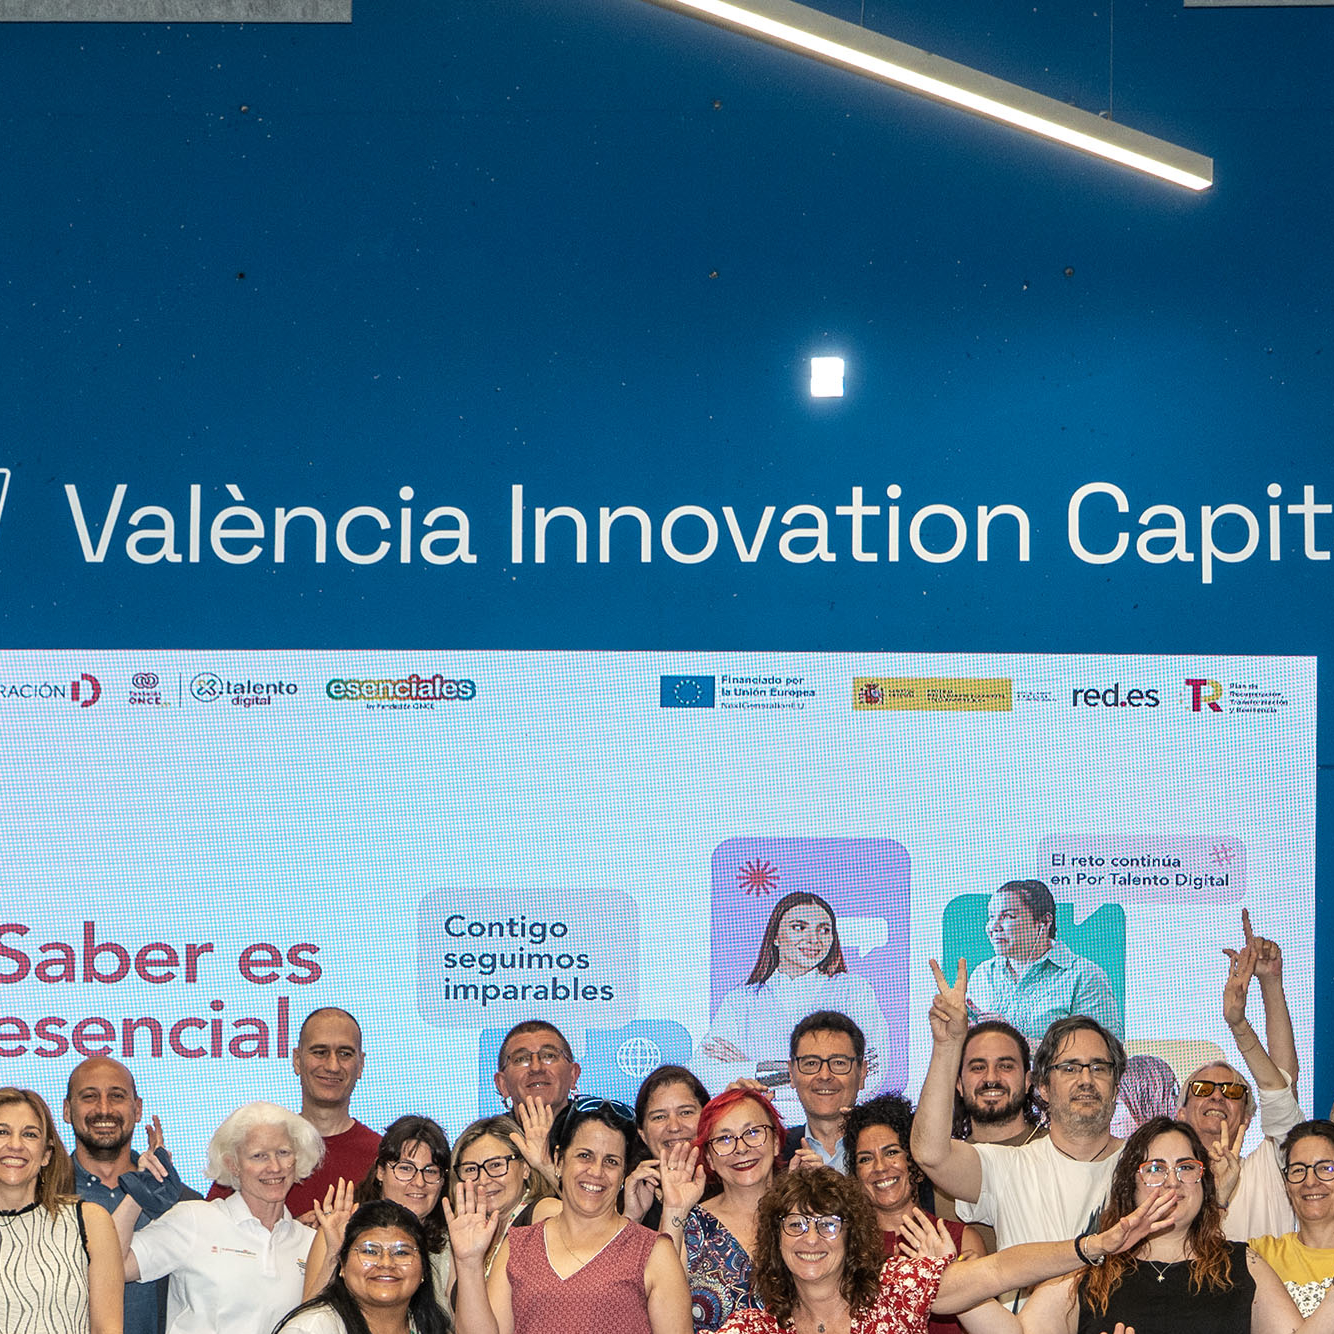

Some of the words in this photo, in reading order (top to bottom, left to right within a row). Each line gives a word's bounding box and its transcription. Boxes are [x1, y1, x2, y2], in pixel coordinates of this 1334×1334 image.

[64, 483, 476, 565] València
[510, 483, 1031, 564] Innovation
[226, 680, 298, 695] talento
[327, 674, 475, 699] esenciales
[721, 675, 782, 685] Financiado
[785, 677, 805, 687] por
[129, 697, 161, 705] ONCE
[231, 695, 271, 708] digital
[721, 687, 731, 697] la
[734, 687, 767, 697] Unión
[770, 687, 816, 698] Europea
[1072, 682, 1160, 708] red.es
[1051, 853, 1066, 867] El
[1071, 854, 1105, 867] reto
[1110, 853, 1181, 868] continúa
[1050, 875, 1070, 886] en
[1076, 873, 1105, 886] Por
[1110, 872, 1170, 887] Talento
[1175, 873, 1229, 890] Digital
[444, 914, 568, 945] Contigo
[238, 942, 323, 986] es
[444, 946, 590, 976] seguimos
[444, 976, 614, 1007] imparables
